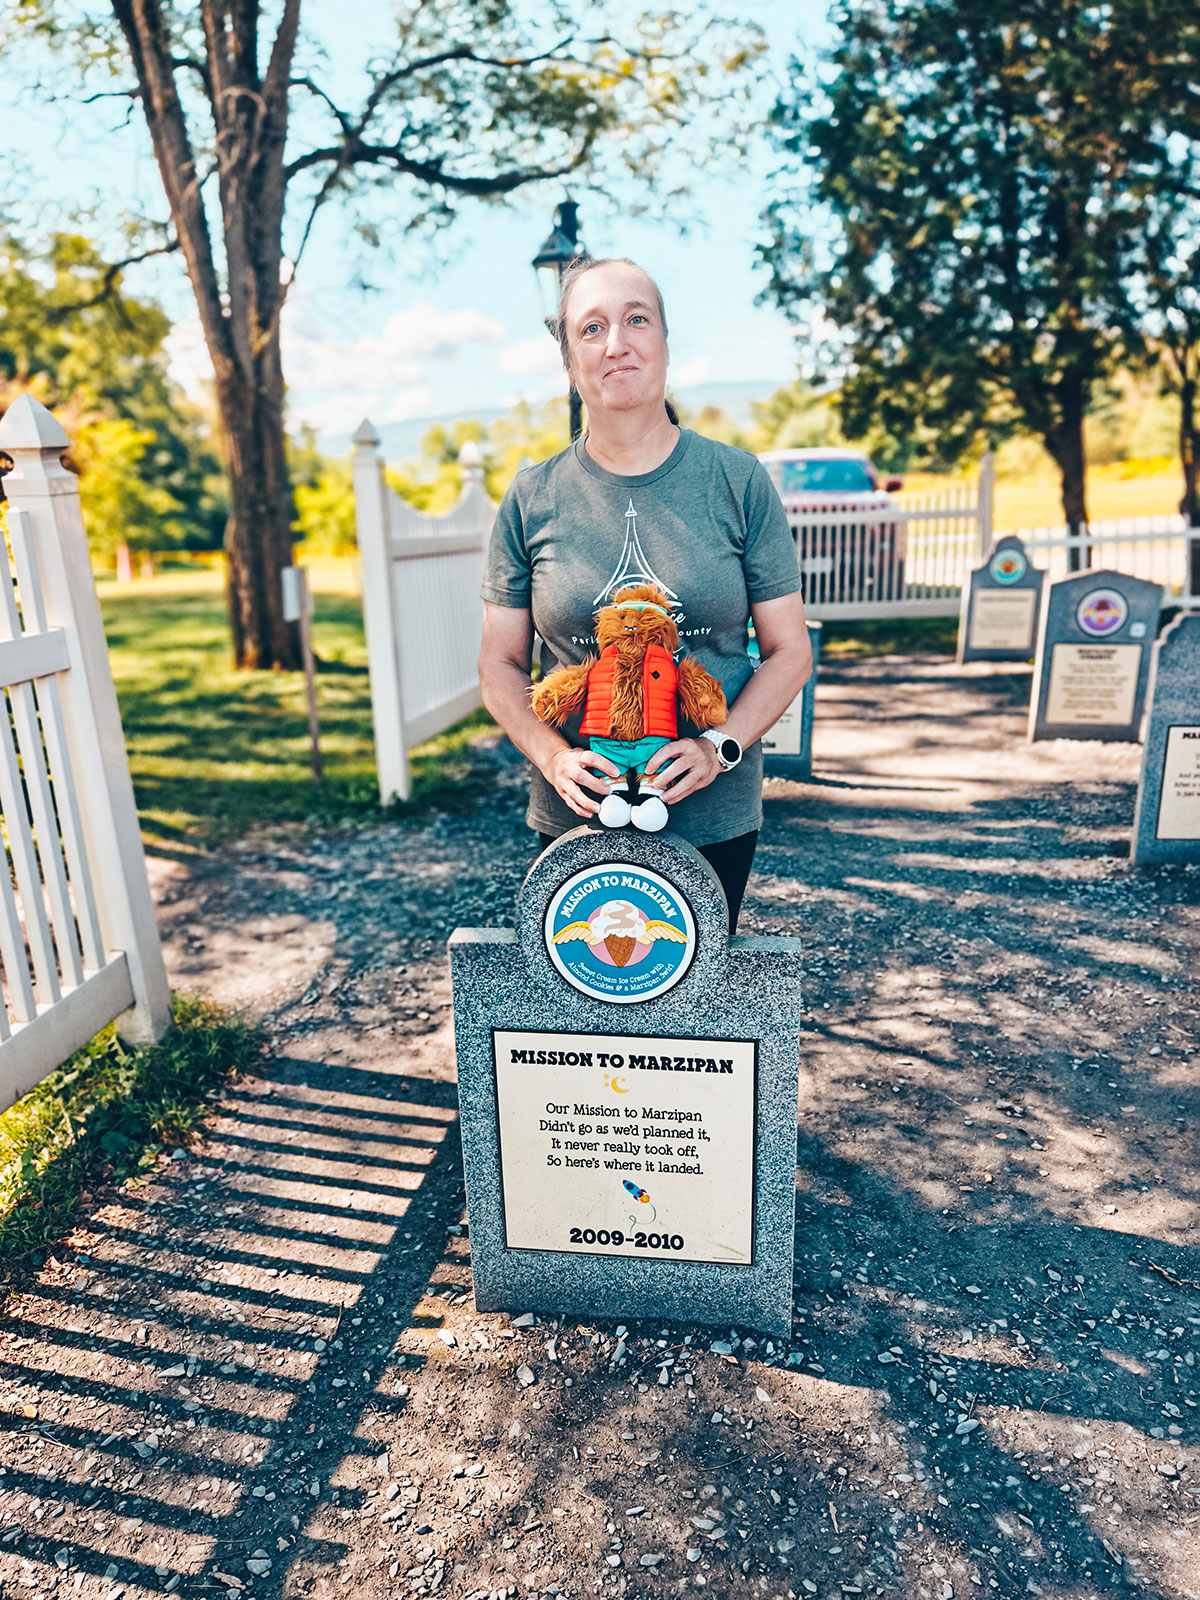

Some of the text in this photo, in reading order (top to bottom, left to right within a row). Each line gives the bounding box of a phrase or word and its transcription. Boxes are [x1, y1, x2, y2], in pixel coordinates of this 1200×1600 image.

[678, 627, 712, 638] ounty
[560, 876, 678, 919] MISSION TO MARZIPAN
[568, 962, 588, 982] Almond
[590, 978, 614, 991] Cookies
[630, 976, 661, 991] Marzipan
[660, 963, 675, 979] Swirl
[578, 962, 596, 978] Sweet
[596, 974, 617, 984] Cream
[630, 973, 650, 984] Cream
[650, 962, 665, 975] with
[510, 1049, 734, 1074] MISSION TO MARZIPAN
[546, 1102, 702, 1122] Our Mission to Marzipan
[539, 1120, 711, 1142] Didn't go as we'd planned it,
[551, 1138, 700, 1159] It never really took off,
[547, 1154, 704, 1176] So here's where it landed.
[569, 1227, 685, 1250] 2009-2010
